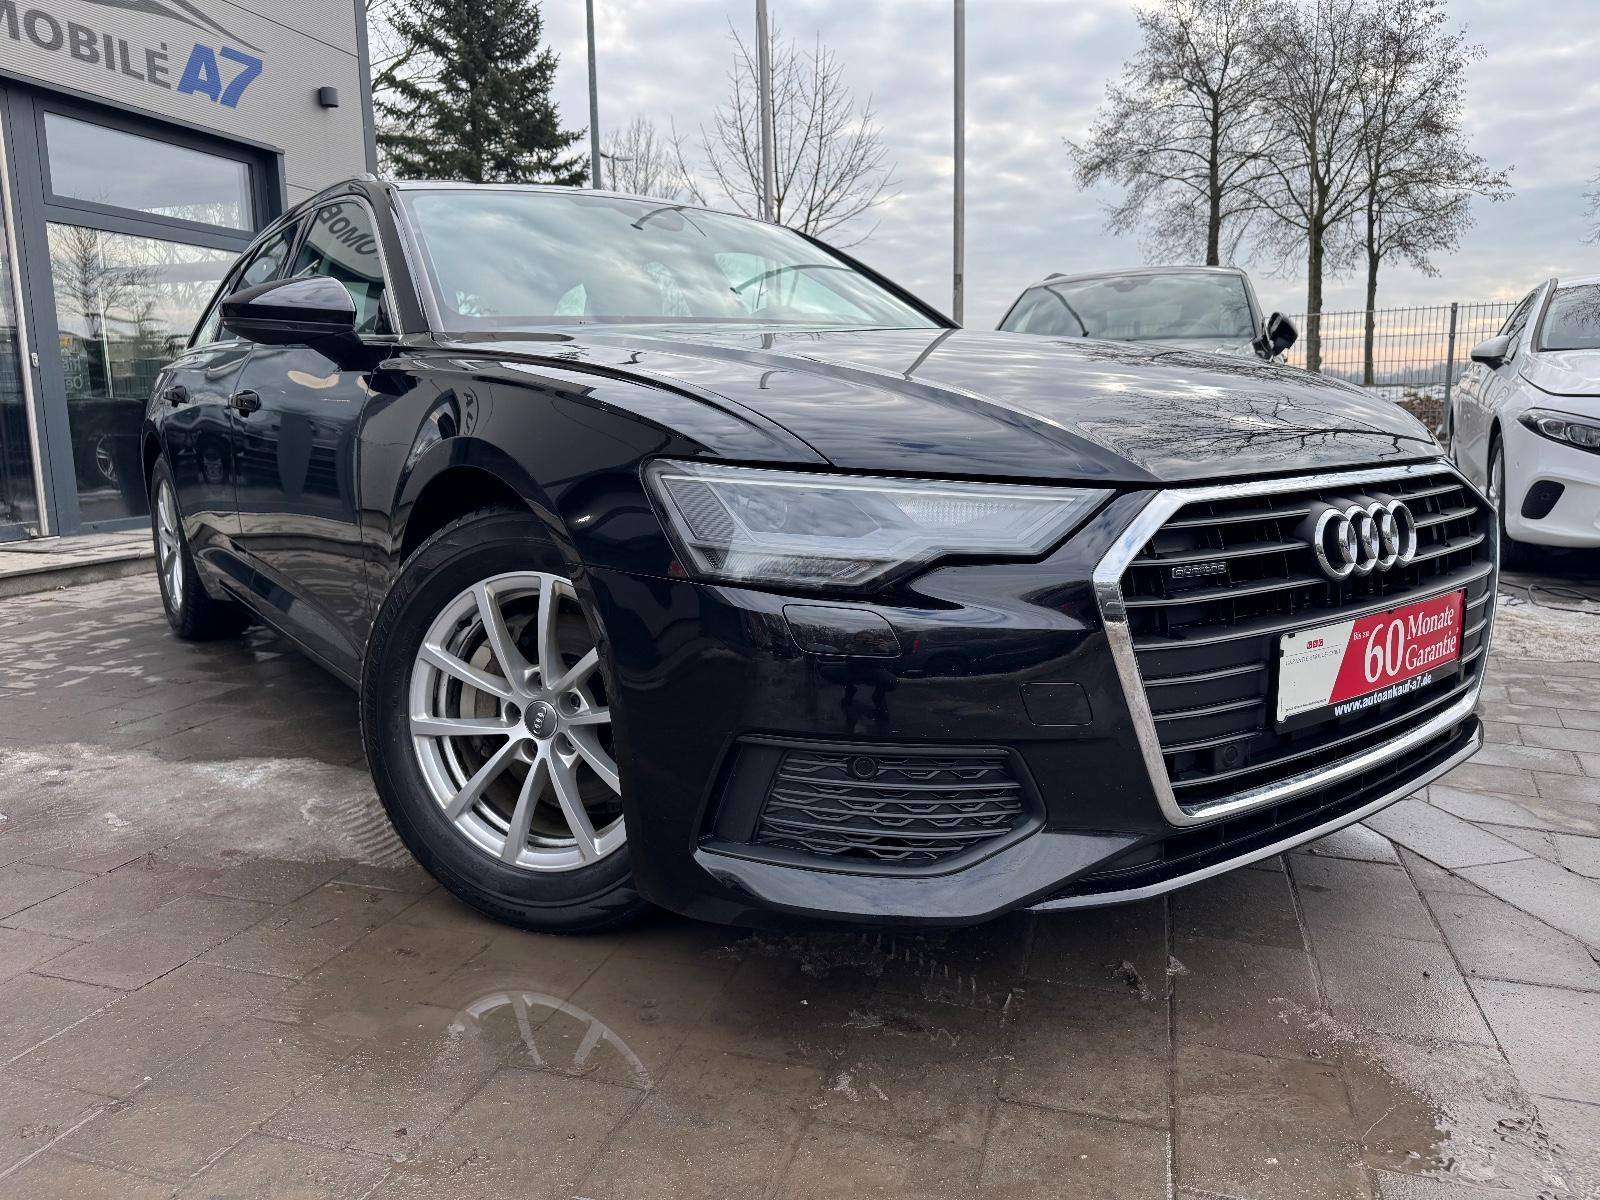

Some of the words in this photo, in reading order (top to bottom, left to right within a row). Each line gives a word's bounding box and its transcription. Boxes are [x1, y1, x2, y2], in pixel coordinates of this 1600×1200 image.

[177, 43, 263, 109] A7
[1353, 631, 1362, 641] Bis
[1364, 619, 1405, 683] 60
[1406, 606, 1455, 640] Monate
[1405, 630, 1457, 670] Garantie
[1334, 673, 1432, 716] www.autoankauf-a7.de
